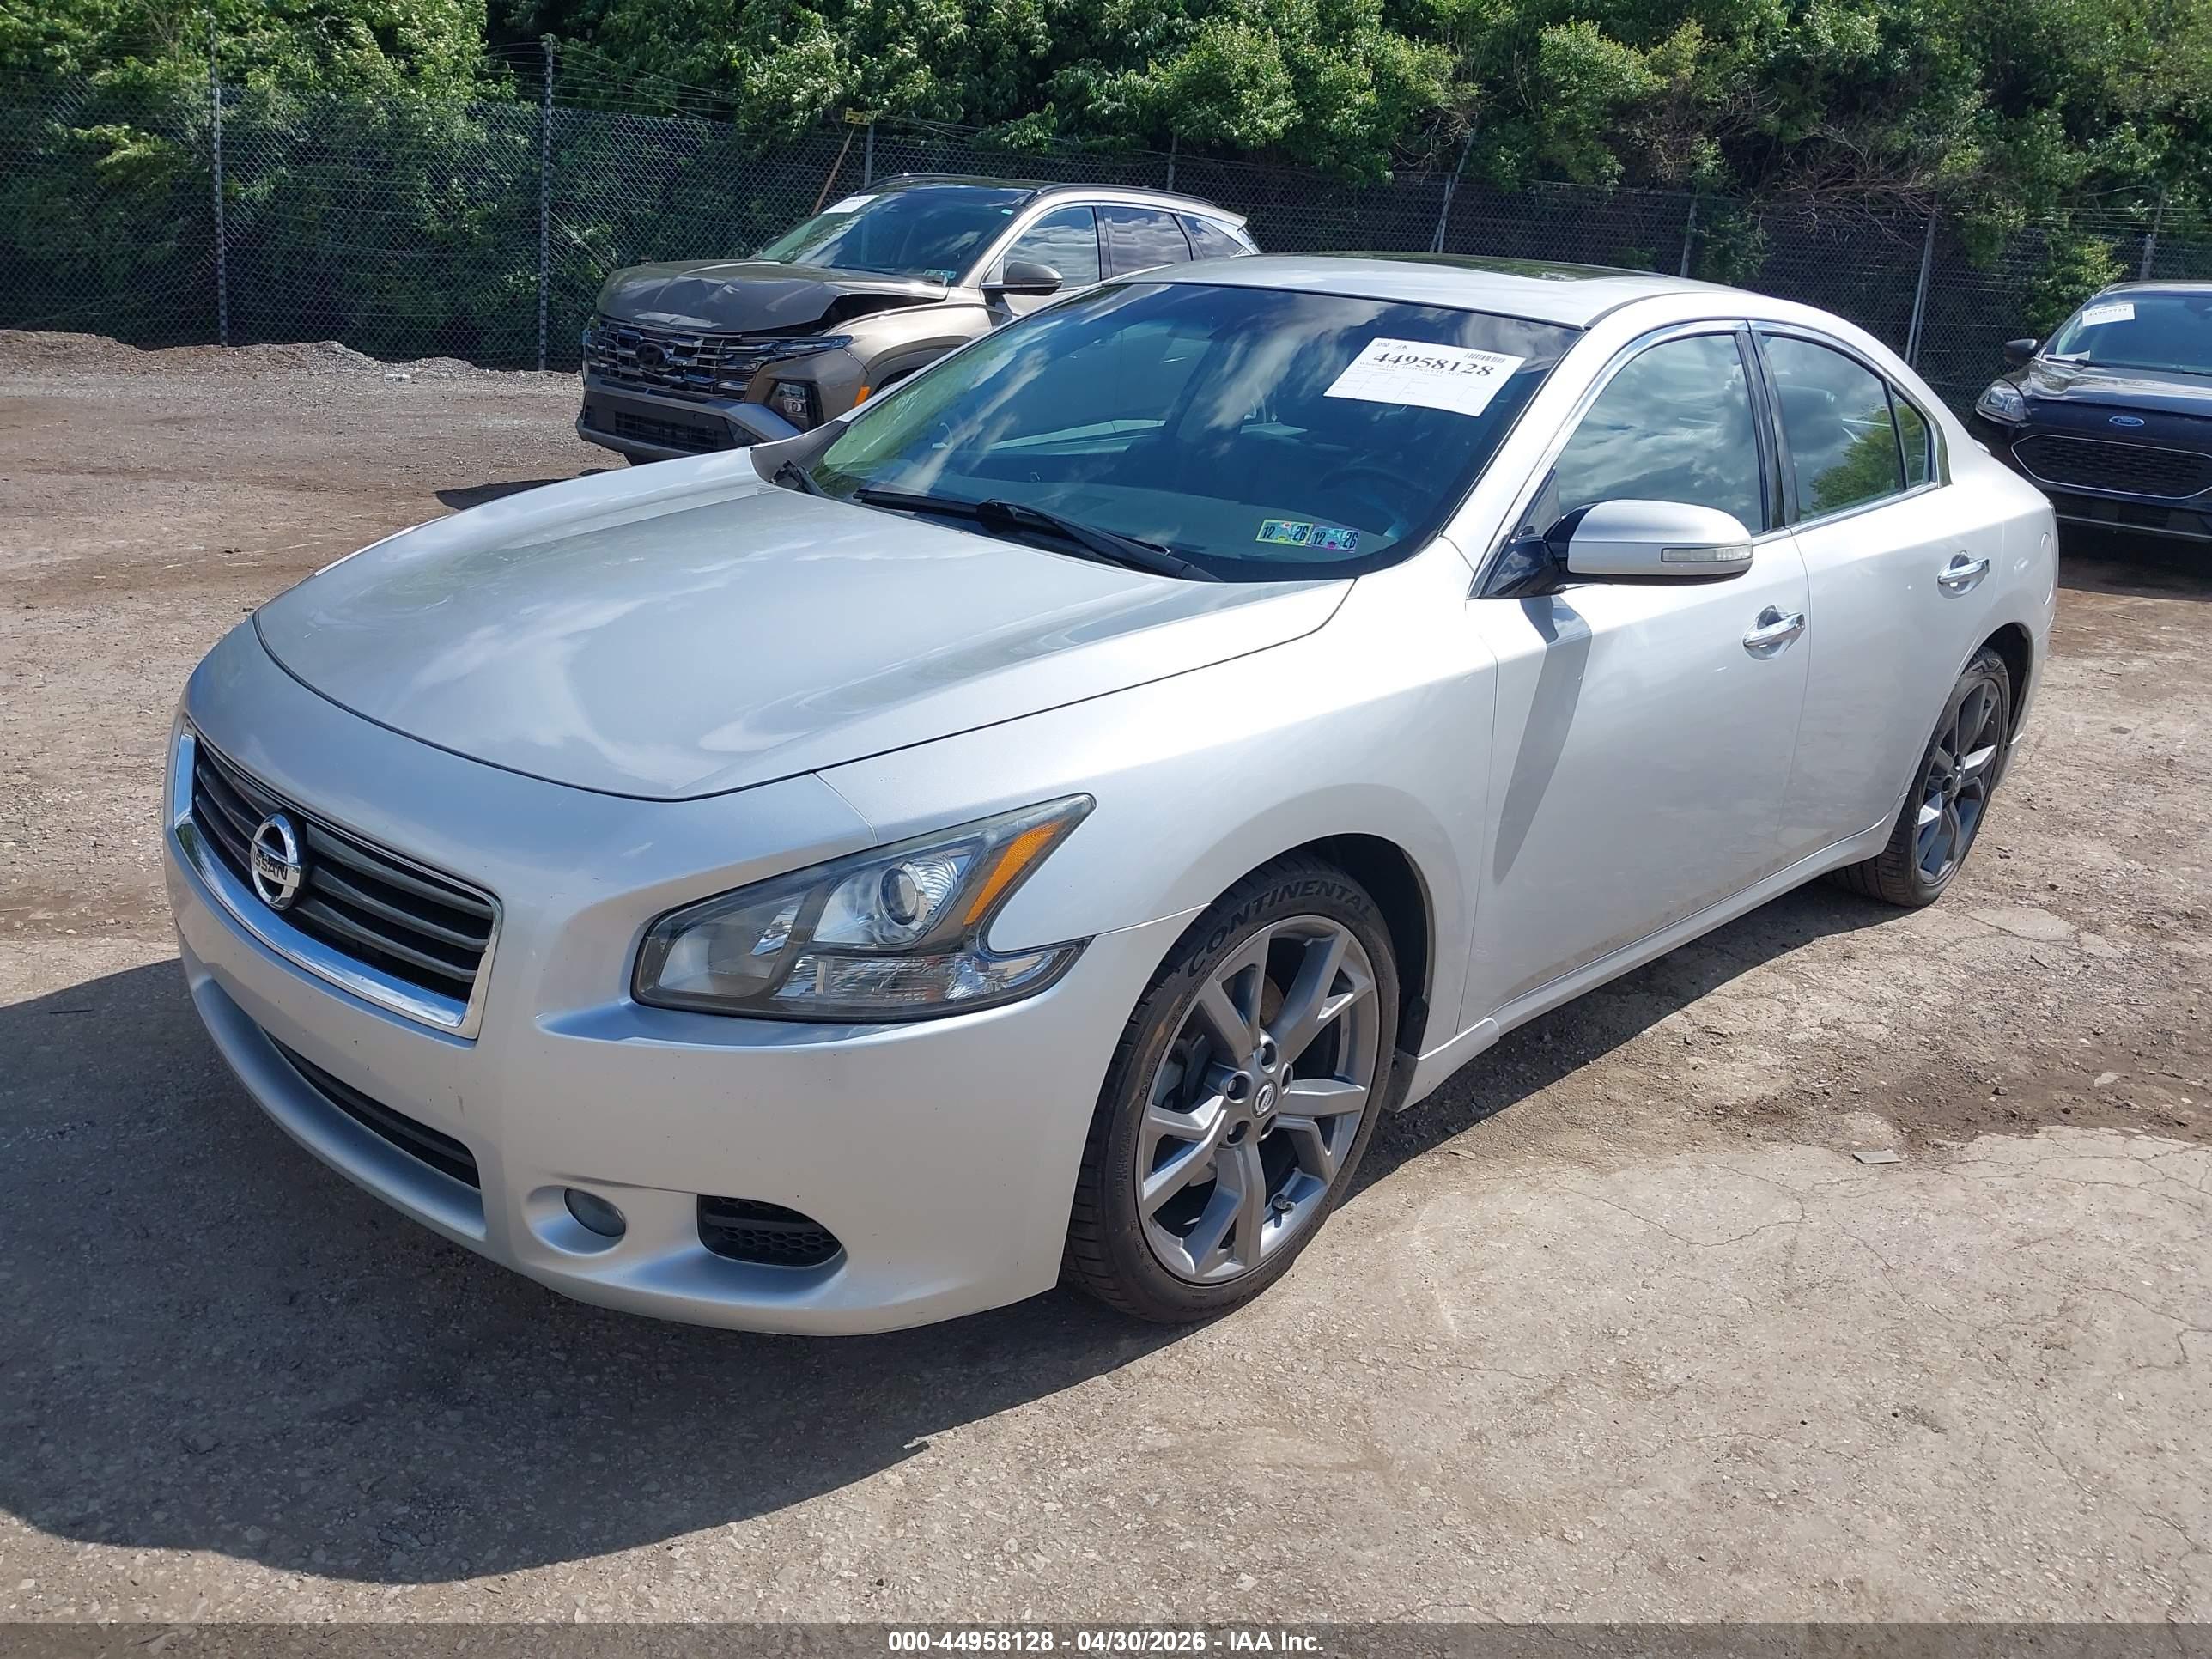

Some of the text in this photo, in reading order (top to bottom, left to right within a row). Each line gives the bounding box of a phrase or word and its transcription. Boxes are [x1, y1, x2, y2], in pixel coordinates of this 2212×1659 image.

[1373, 352, 1494, 376] 44958128
[1262, 526, 1309, 542] 12 26
[1312, 532, 1358, 549] 12 26
[252, 850, 289, 880] ISSAN
[1188, 879, 1373, 978] CONTINENTAL
